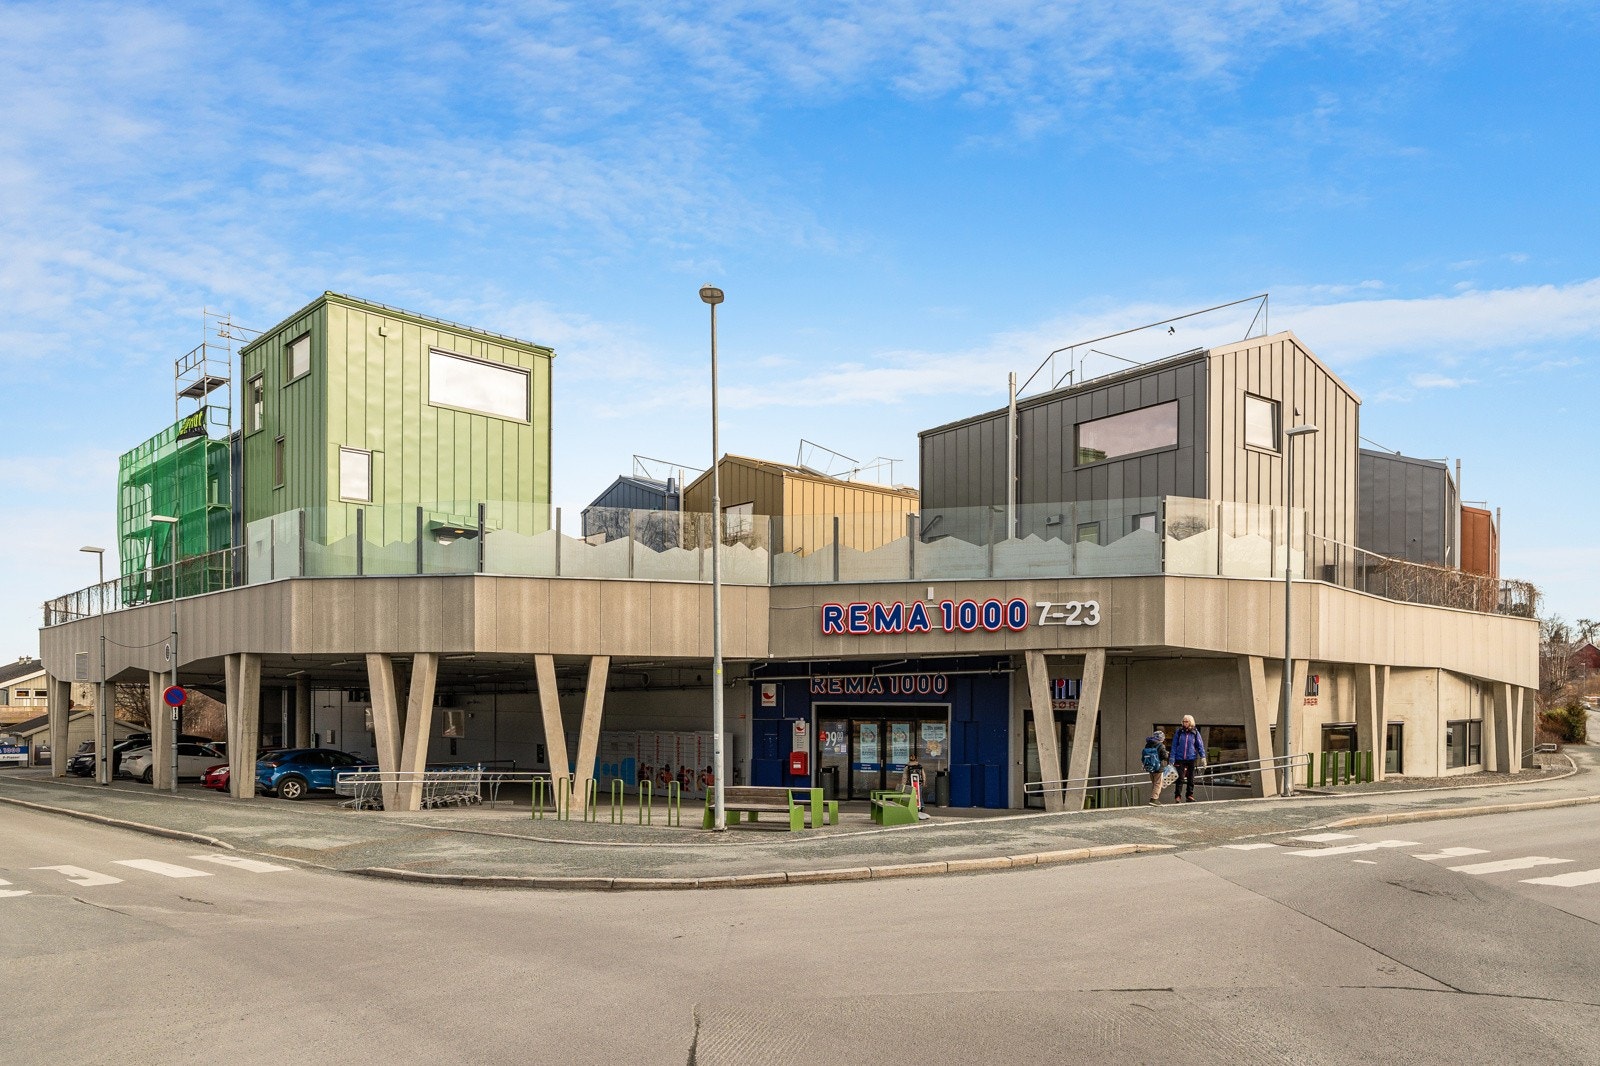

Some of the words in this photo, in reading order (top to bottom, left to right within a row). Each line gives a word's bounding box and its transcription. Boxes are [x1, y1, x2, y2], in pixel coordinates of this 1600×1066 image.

[821, 601, 932, 636] REMA
[938, 597, 1030, 634] 1000
[1035, 600, 1102, 627] 7-23
[809, 674, 885, 695] REMA
[888, 673, 948, 695] 1000
